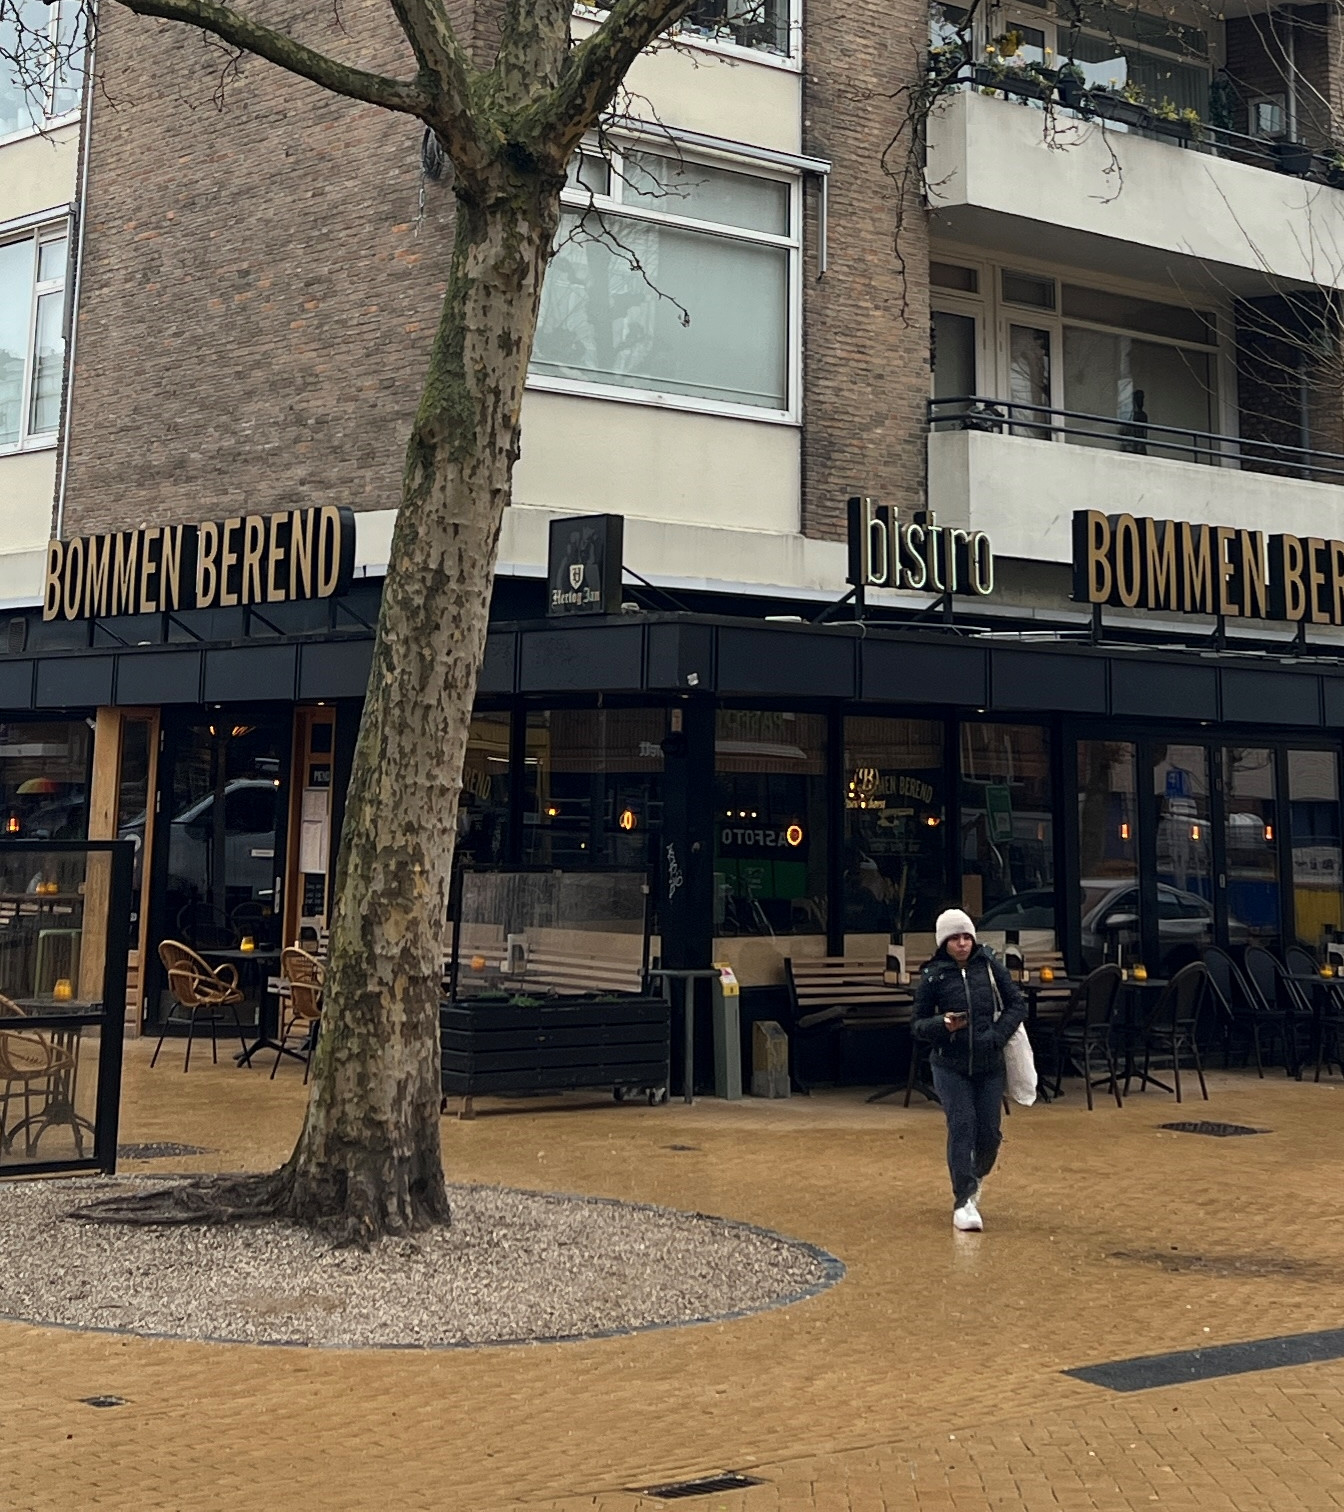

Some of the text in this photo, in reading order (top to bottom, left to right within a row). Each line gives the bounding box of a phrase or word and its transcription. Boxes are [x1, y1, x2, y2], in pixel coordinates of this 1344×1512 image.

[43, 506, 341, 622] BOMMEN BEREND
[552, 588, 601, 606] Hertog Jan
[866, 496, 994, 596] bistro
[1087, 509, 1269, 618] BOMMEN
